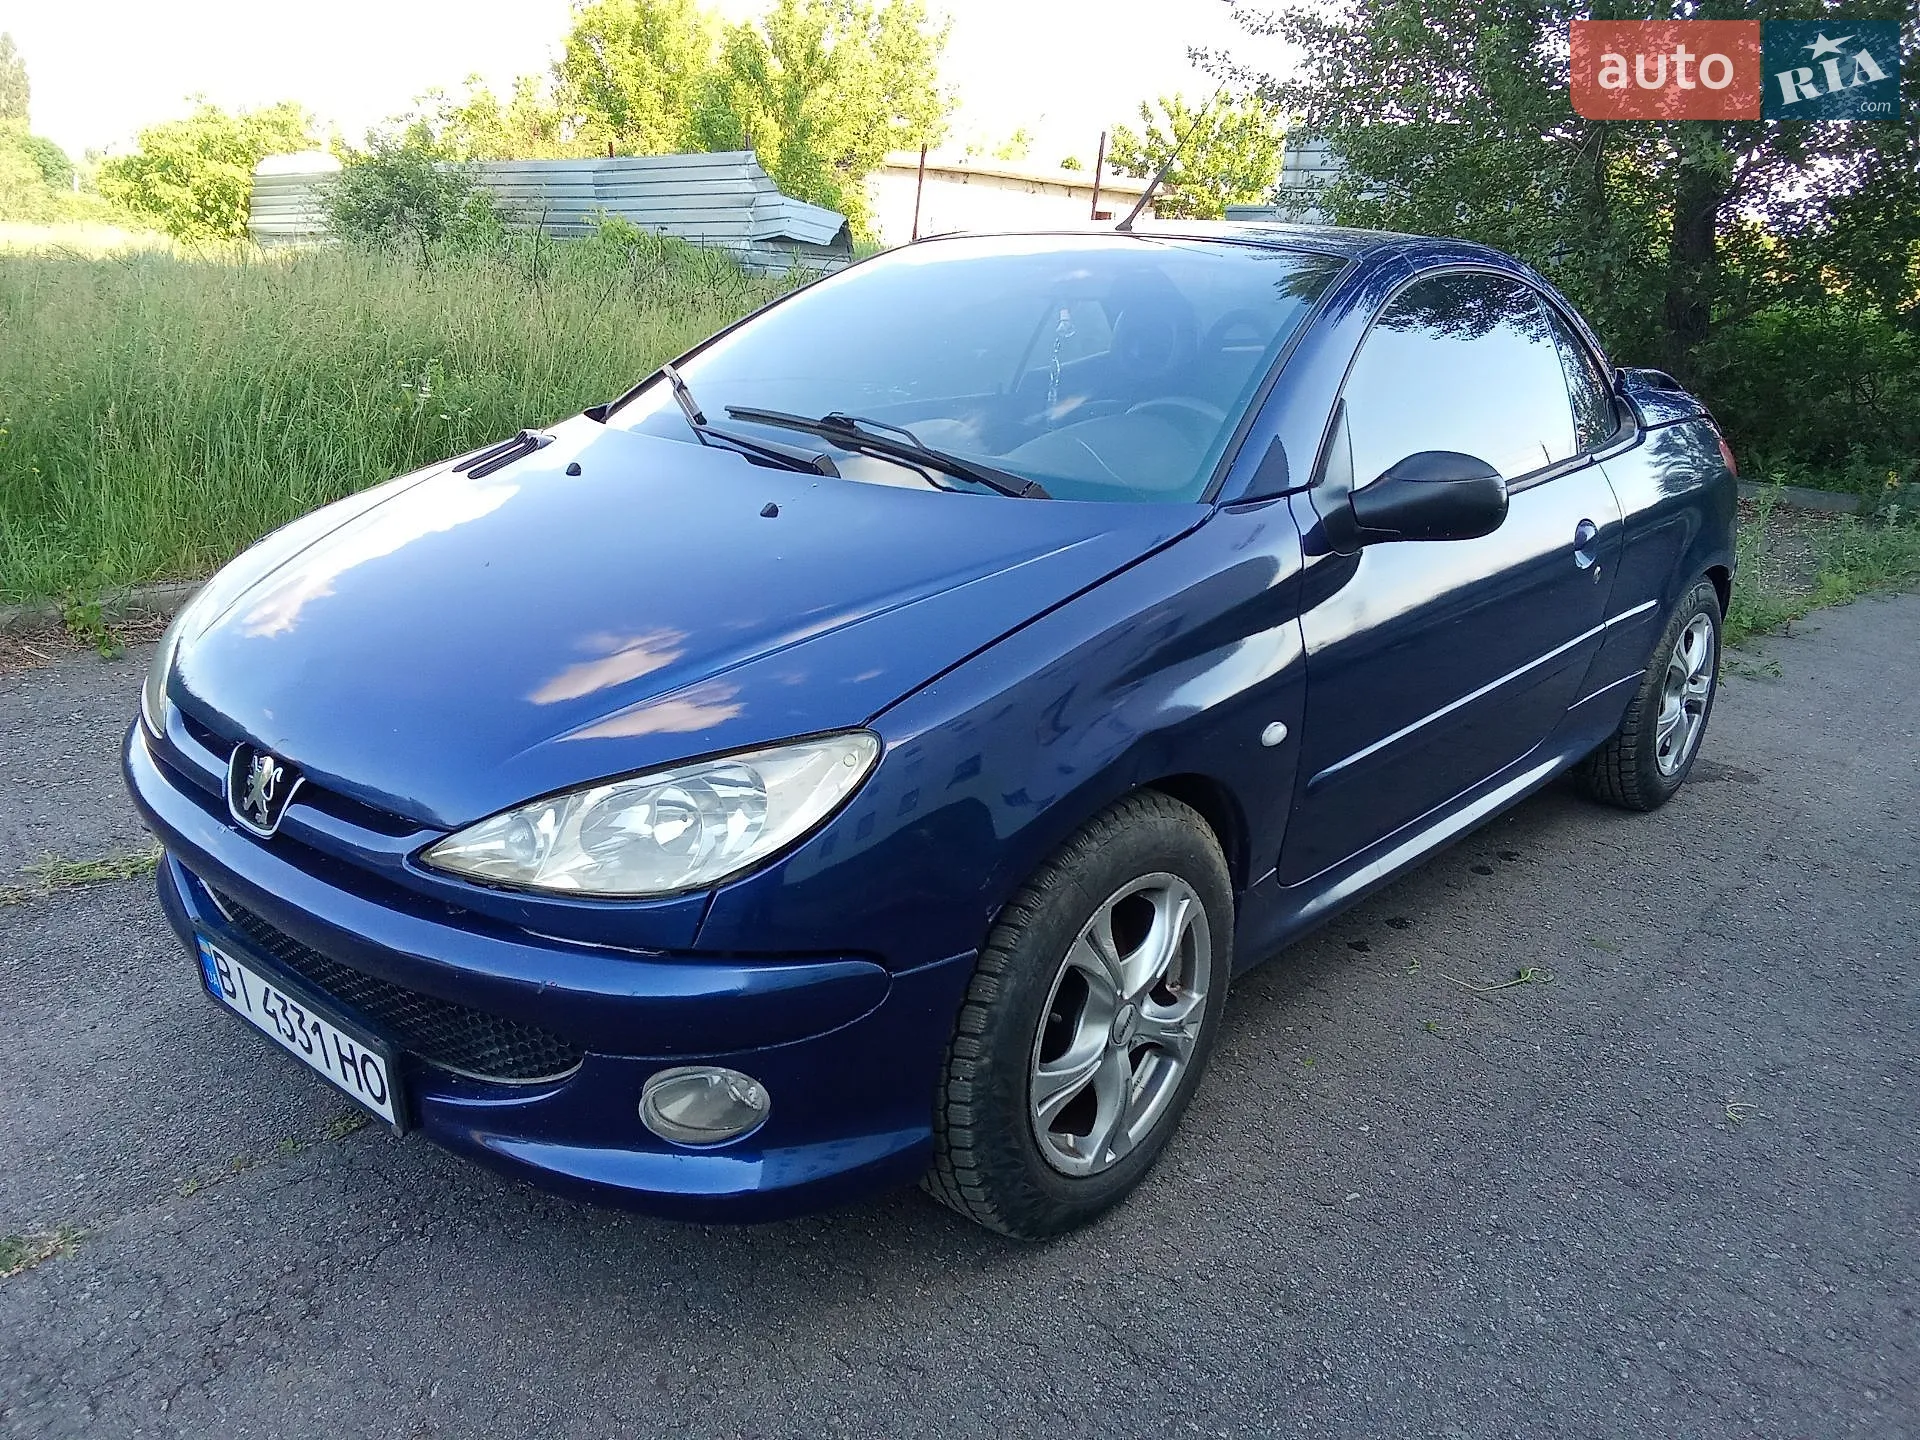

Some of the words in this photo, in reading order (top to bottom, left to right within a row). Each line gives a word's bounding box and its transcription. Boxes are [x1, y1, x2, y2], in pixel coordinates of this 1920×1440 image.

[205, 968, 220, 989] UA
[212, 949, 252, 1012] BI
[262, 987, 332, 1071] 4331
[333, 1033, 387, 1106] HO
